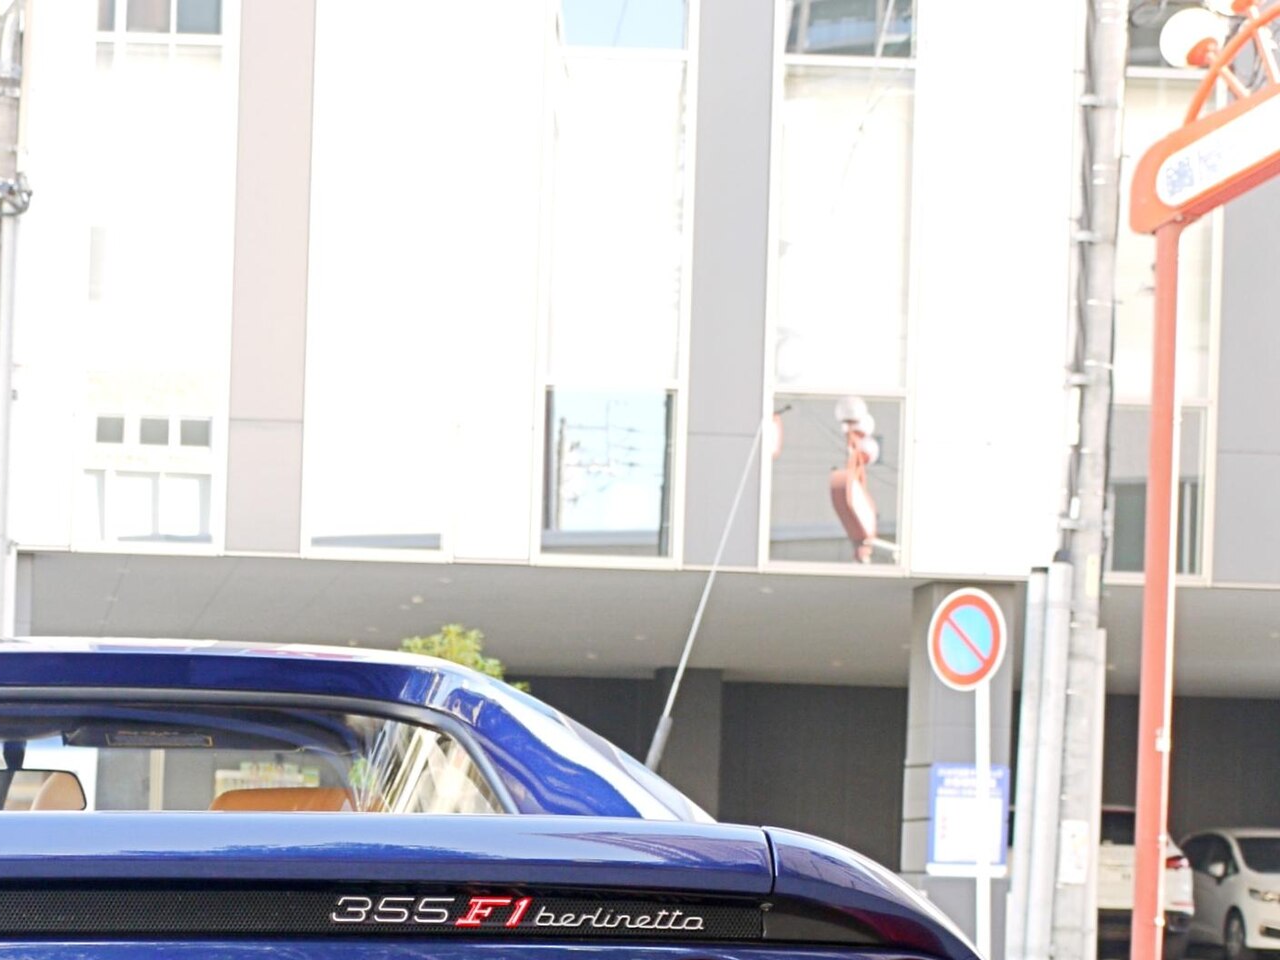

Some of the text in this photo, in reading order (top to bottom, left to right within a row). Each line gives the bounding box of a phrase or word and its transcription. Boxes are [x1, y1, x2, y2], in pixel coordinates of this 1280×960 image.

[331, 895, 705, 931] 355 F1 berlinetta
